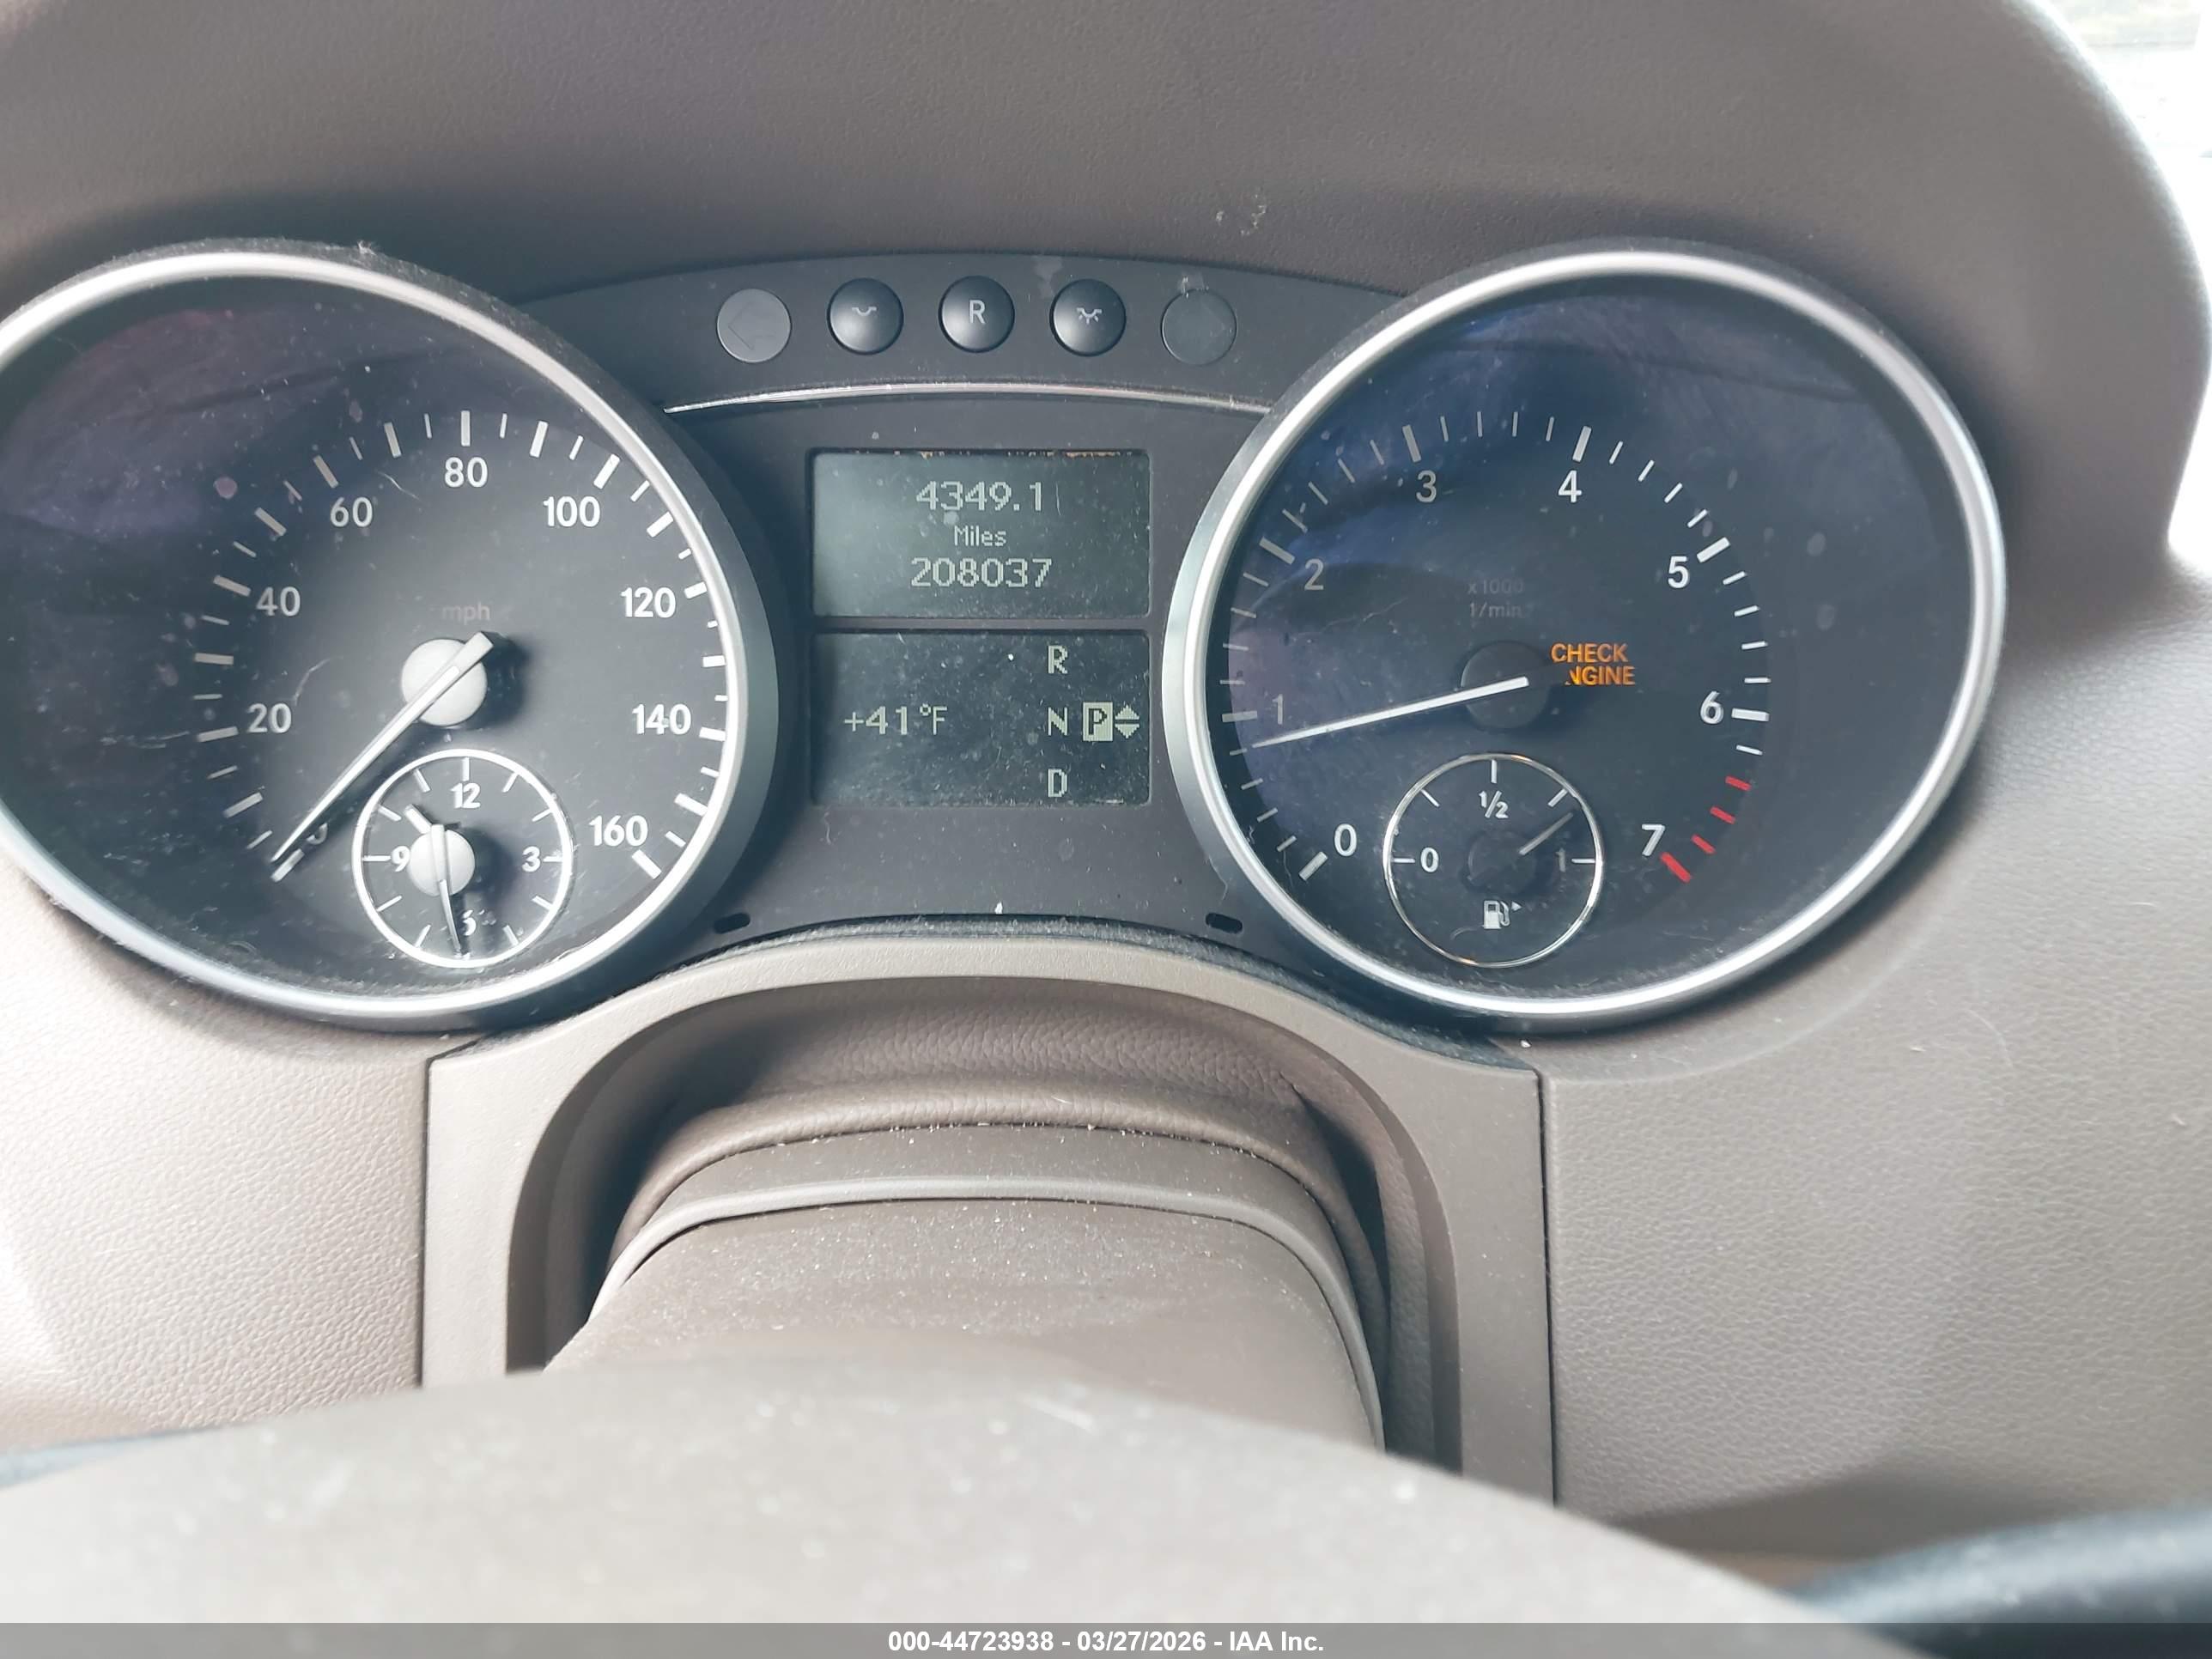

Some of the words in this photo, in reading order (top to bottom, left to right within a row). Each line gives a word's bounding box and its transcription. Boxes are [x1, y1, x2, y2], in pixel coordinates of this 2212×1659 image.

[969, 300, 985, 325] R
[444, 457, 488, 488] 80
[1416, 471, 1437, 502] 3
[1558, 471, 1582, 502] 4
[543, 495, 601, 527] 100
[915, 481, 1042, 512] 4349.1
[330, 497, 373, 527] 60
[953, 526, 1007, 547] Miles
[910, 557, 1053, 587] 208037
[1304, 558, 1324, 591] 2
[1668, 556, 1689, 588] 5
[256, 586, 301, 617] 40
[441, 602, 490, 626] mph
[621, 587, 676, 618] 120
[1048, 645, 1068, 674] R
[1550, 642, 1629, 663] CHECK
[1564, 665, 1636, 686] NGINE
[247, 703, 292, 734] 20
[632, 704, 691, 735] 140
[1047, 707, 1068, 736] N
[1087, 708, 1108, 735] P
[1271, 694, 1285, 725] 1
[1699, 691, 1724, 724] 6
[449, 782, 481, 809] 12
[1047, 769, 1068, 798] D
[588, 815, 647, 847] 160
[1334, 823, 1357, 856] 0
[1641, 823, 1665, 855] 7
[391, 845, 410, 872] 9
[521, 846, 541, 872] 3
[1419, 847, 1440, 872] 0
[1554, 848, 1566, 872] 1
